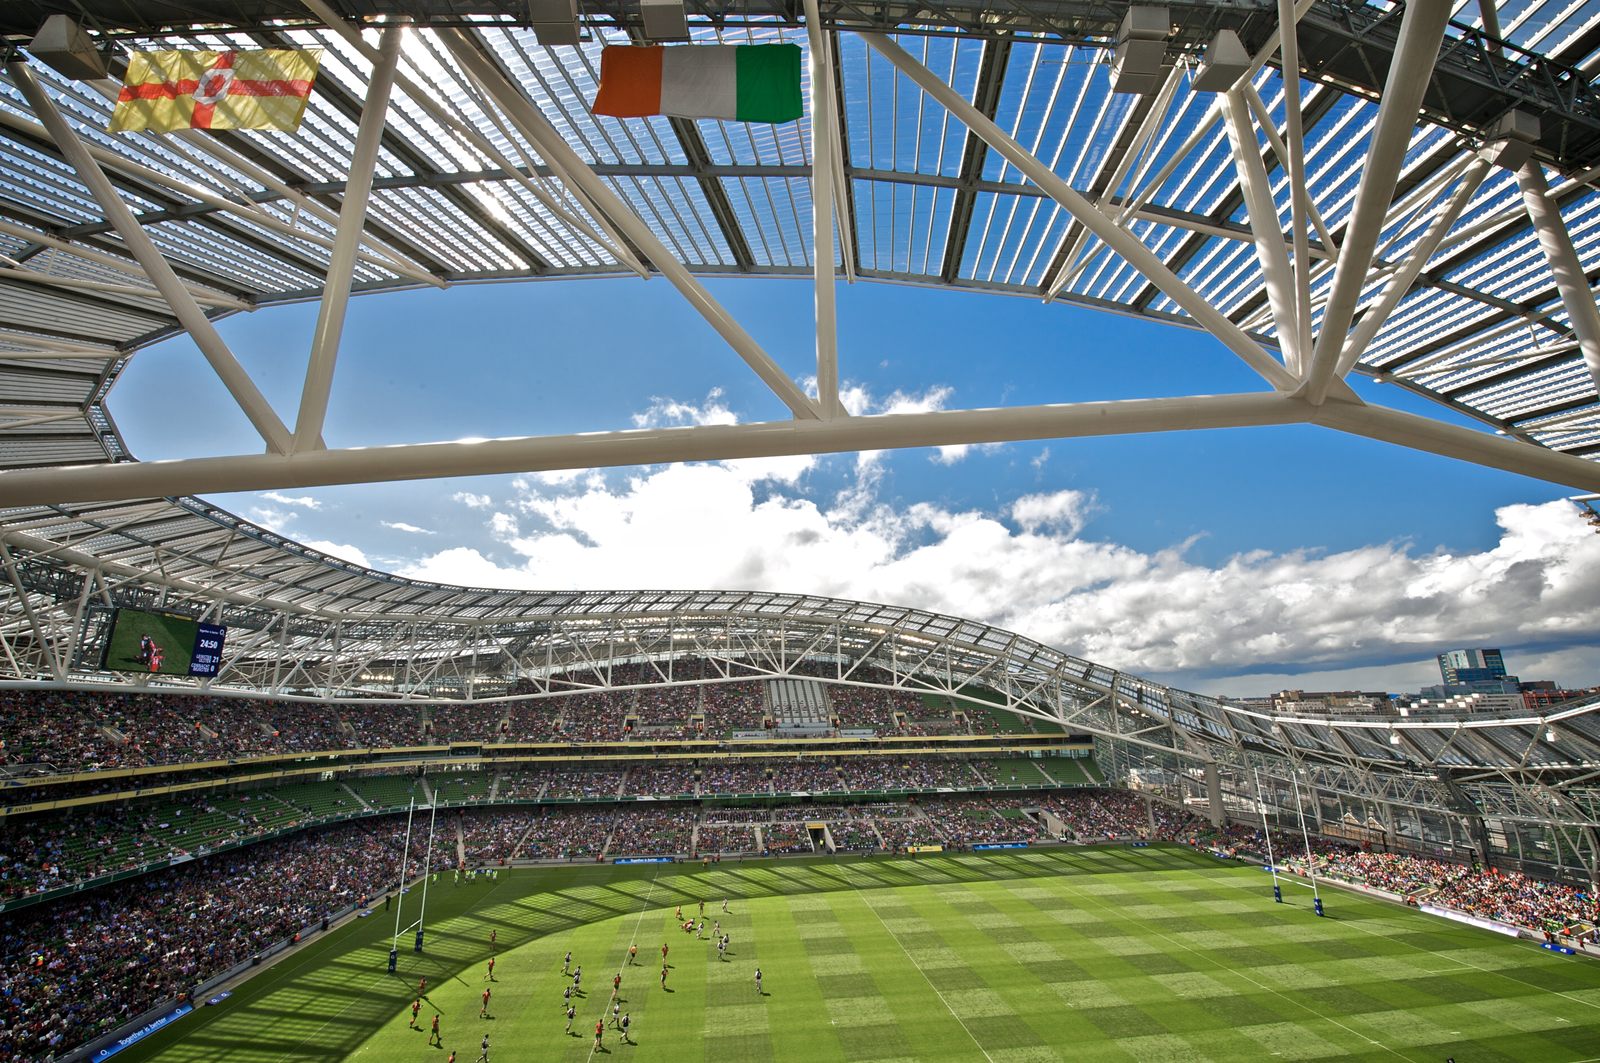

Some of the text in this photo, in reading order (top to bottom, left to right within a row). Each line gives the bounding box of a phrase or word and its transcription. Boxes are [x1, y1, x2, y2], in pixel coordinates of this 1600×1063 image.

[200, 639, 218, 649] 24:50
[14, 805, 33, 813] AVIVA
[118, 1029, 144, 1046] Together
[150, 1017, 167, 1029] better
